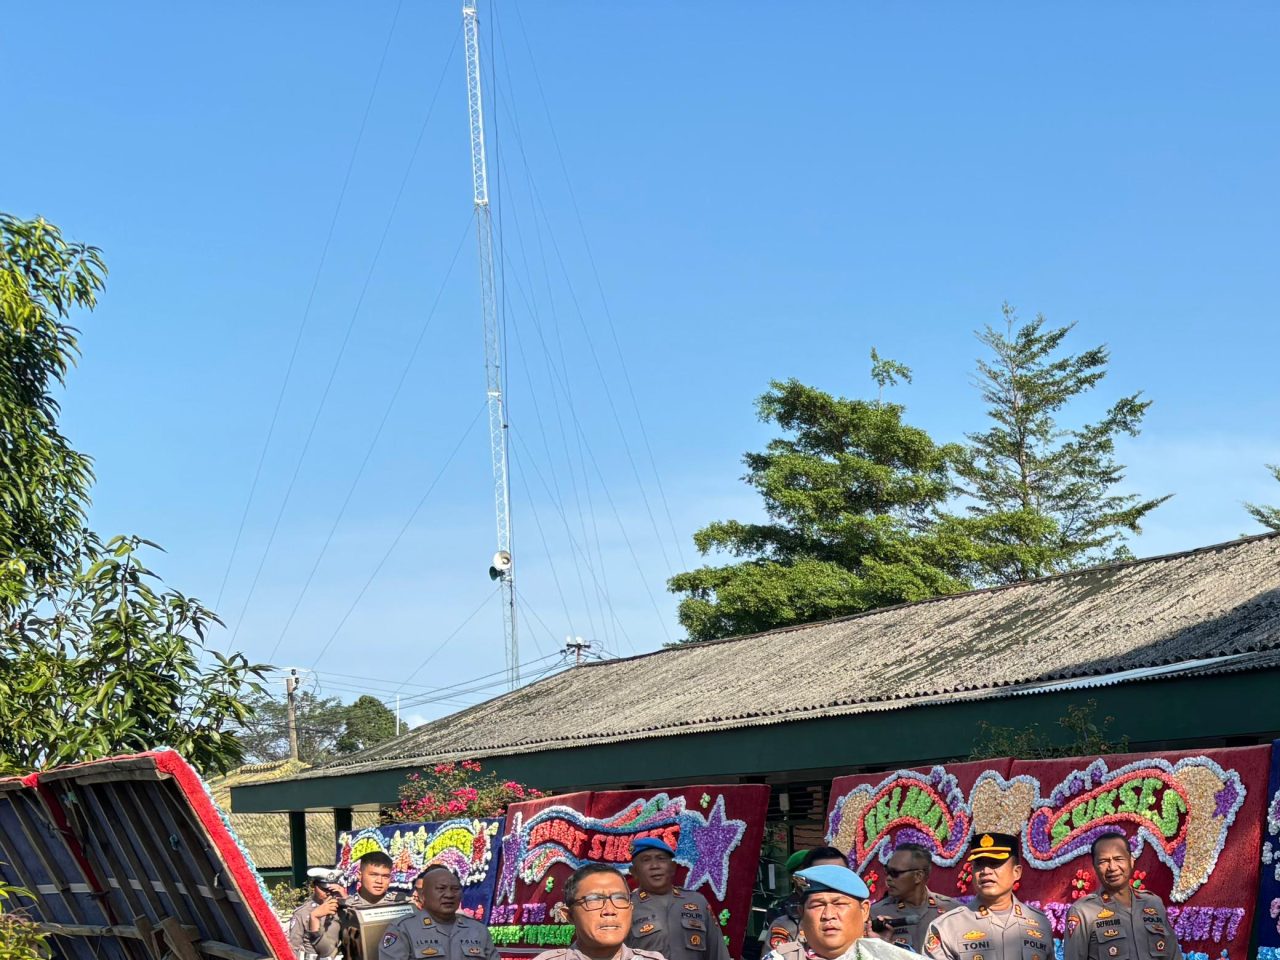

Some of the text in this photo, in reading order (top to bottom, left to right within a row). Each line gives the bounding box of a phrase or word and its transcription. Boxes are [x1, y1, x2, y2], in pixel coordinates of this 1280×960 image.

[1051, 778, 1187, 848] SUKSES
[963, 941, 990, 951] TONI
[1024, 940, 1047, 951] POLRI
